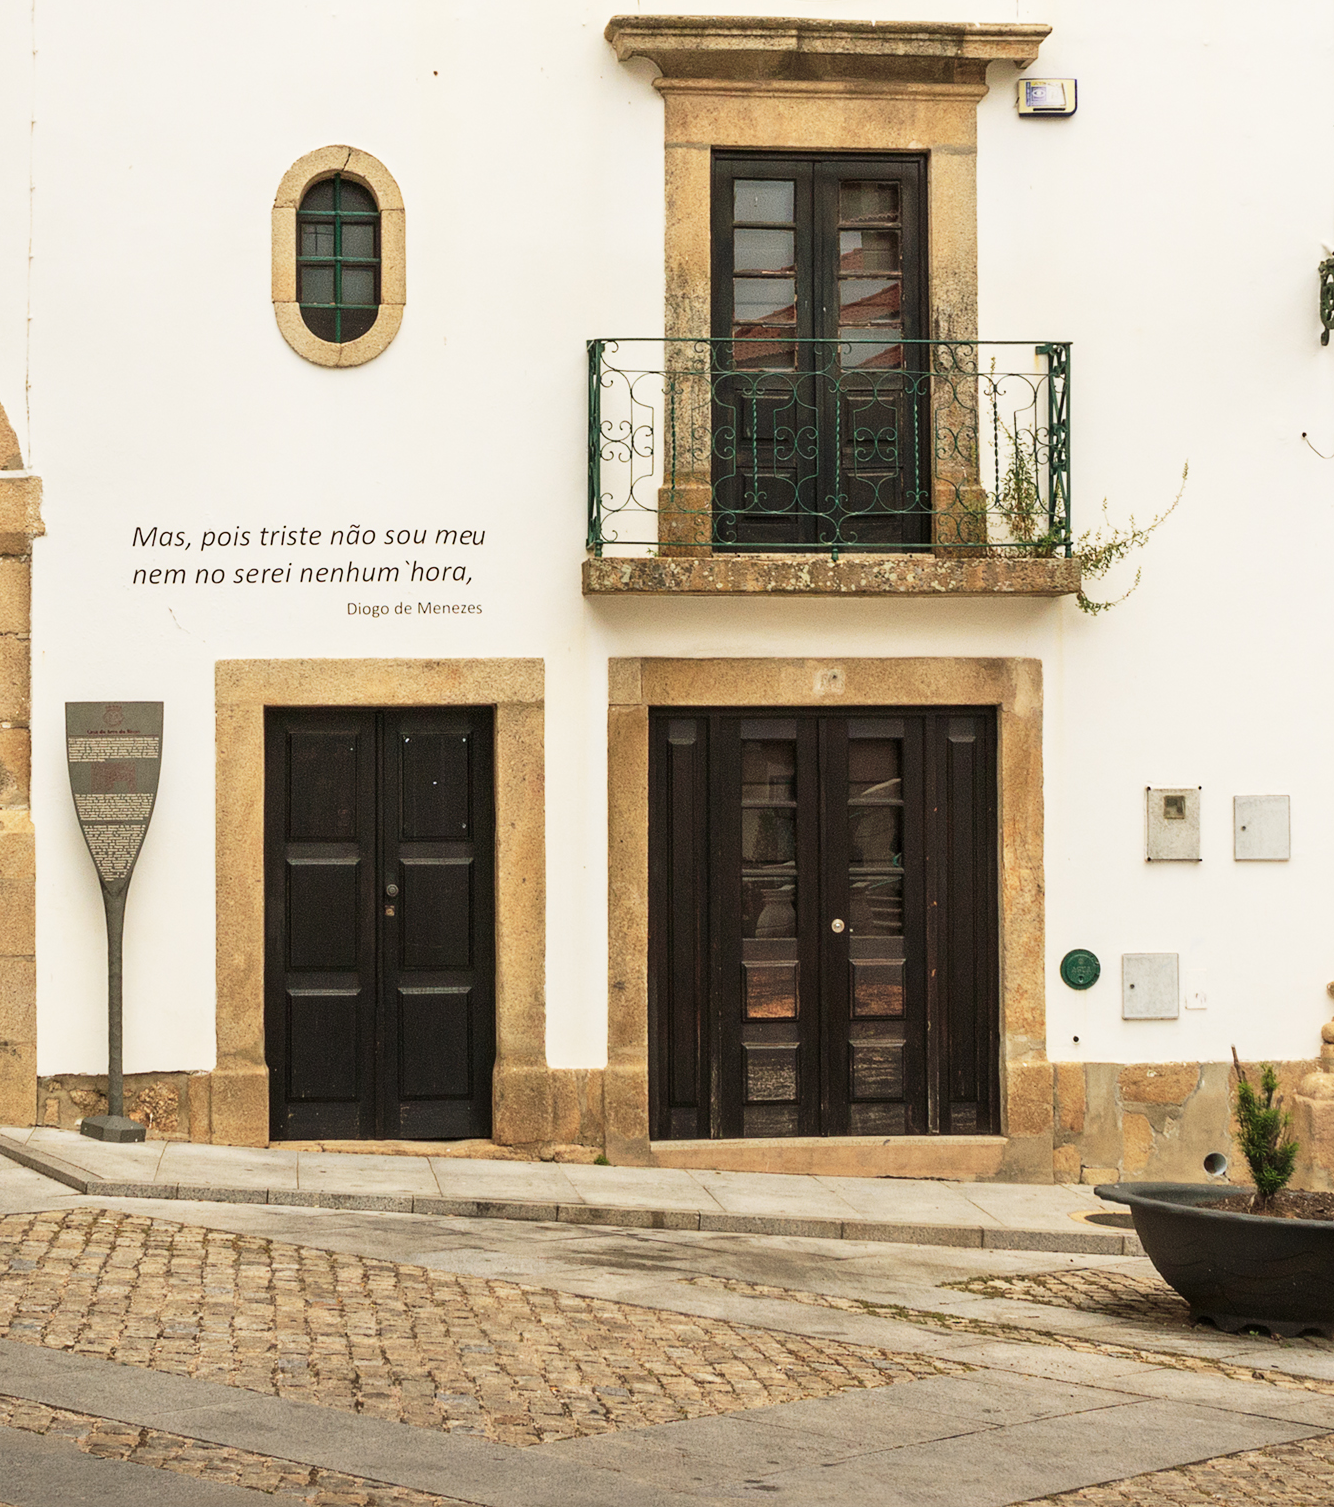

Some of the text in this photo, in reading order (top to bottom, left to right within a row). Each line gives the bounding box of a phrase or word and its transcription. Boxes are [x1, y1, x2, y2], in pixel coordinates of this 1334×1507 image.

[132, 524, 486, 552] Mas, pois triste não sou meu
[132, 568, 186, 585] nem
[195, 568, 225, 585] no
[232, 562, 293, 584] serei
[299, 560, 400, 583] nenhum
[347, 601, 483, 619] Diogo de Menezes
